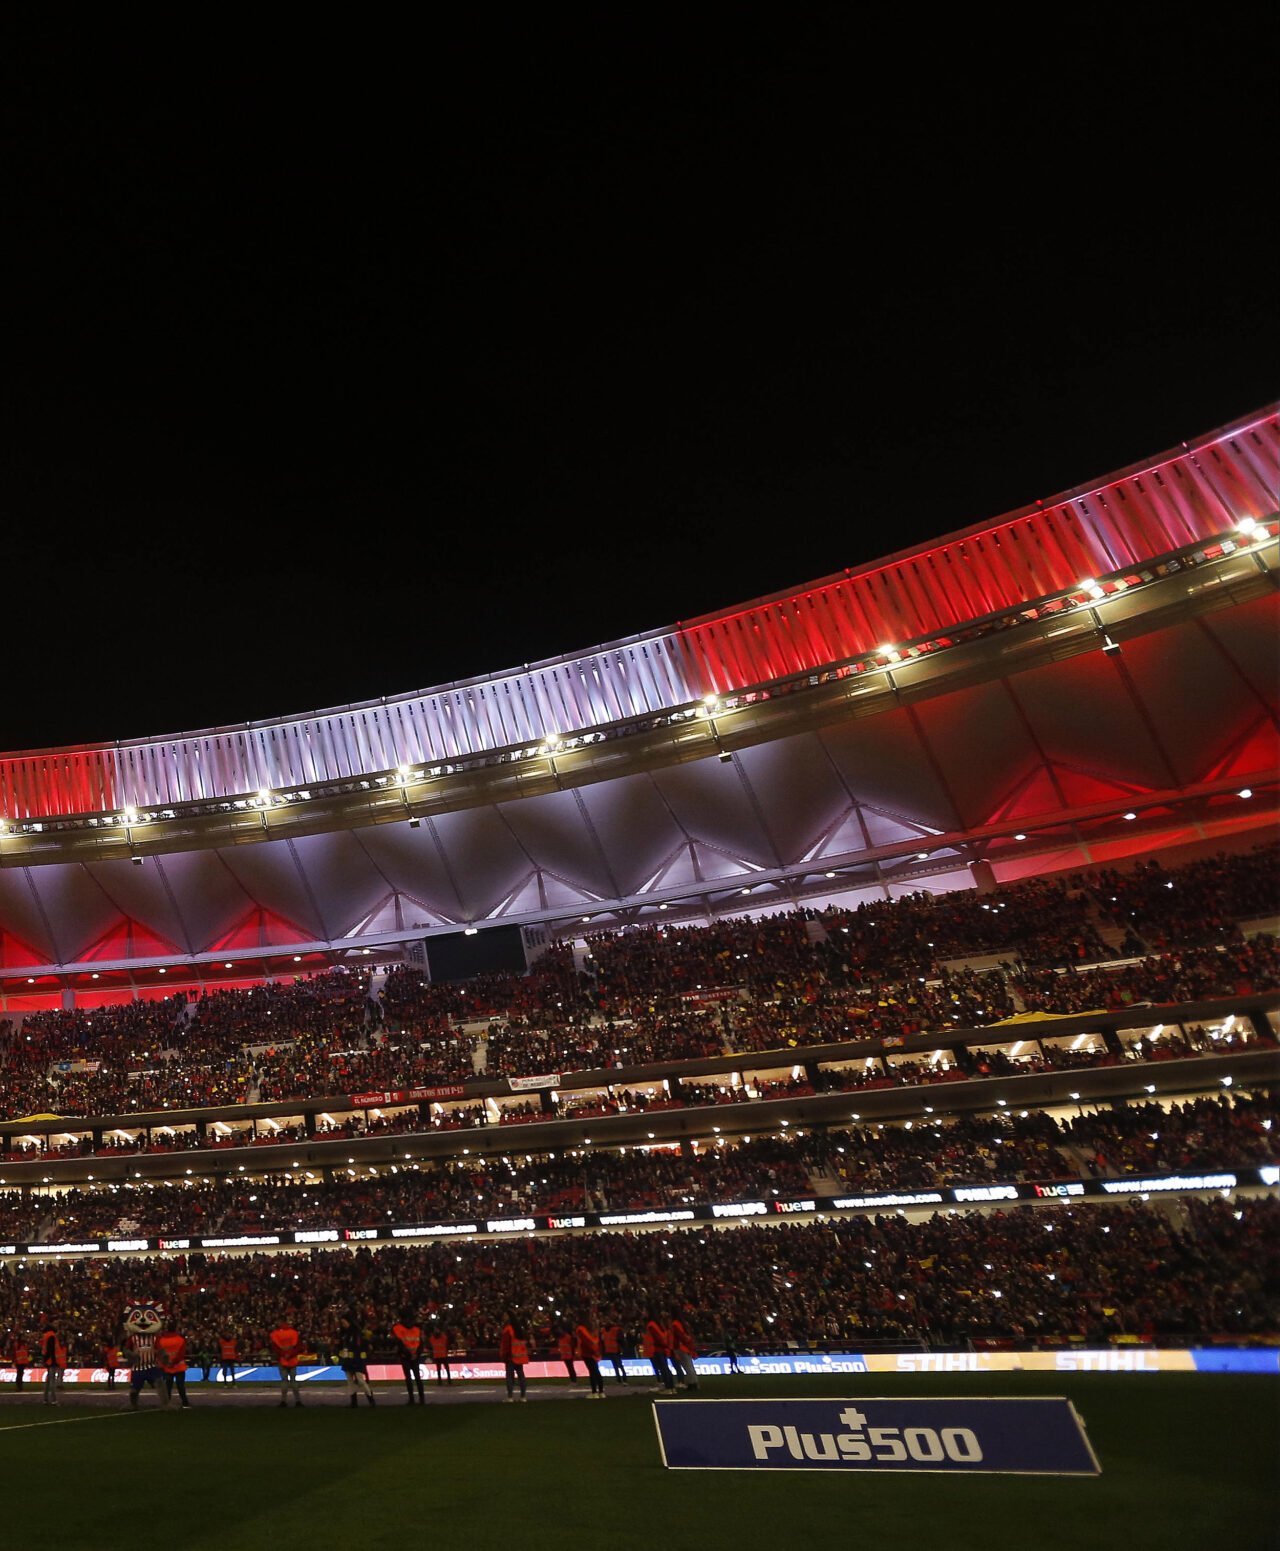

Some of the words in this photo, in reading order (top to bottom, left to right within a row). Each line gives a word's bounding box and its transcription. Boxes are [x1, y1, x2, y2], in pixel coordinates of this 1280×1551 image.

[953, 1185, 1018, 1201] PHILIPS
[1035, 1184, 1067, 1197] hue
[712, 1202, 767, 1218] PHILIPS
[775, 1201, 802, 1213] hue
[548, 1217, 572, 1229] hue
[345, 1229, 366, 1240] hue
[159, 1239, 179, 1249] hue
[793, 1361, 865, 1373] Plus500
[896, 1354, 989, 1371] STIHL
[1056, 1351, 1158, 1371] STIHL
[473, 1368, 518, 1378] Santan
[747, 1425, 983, 1462] Plus500
